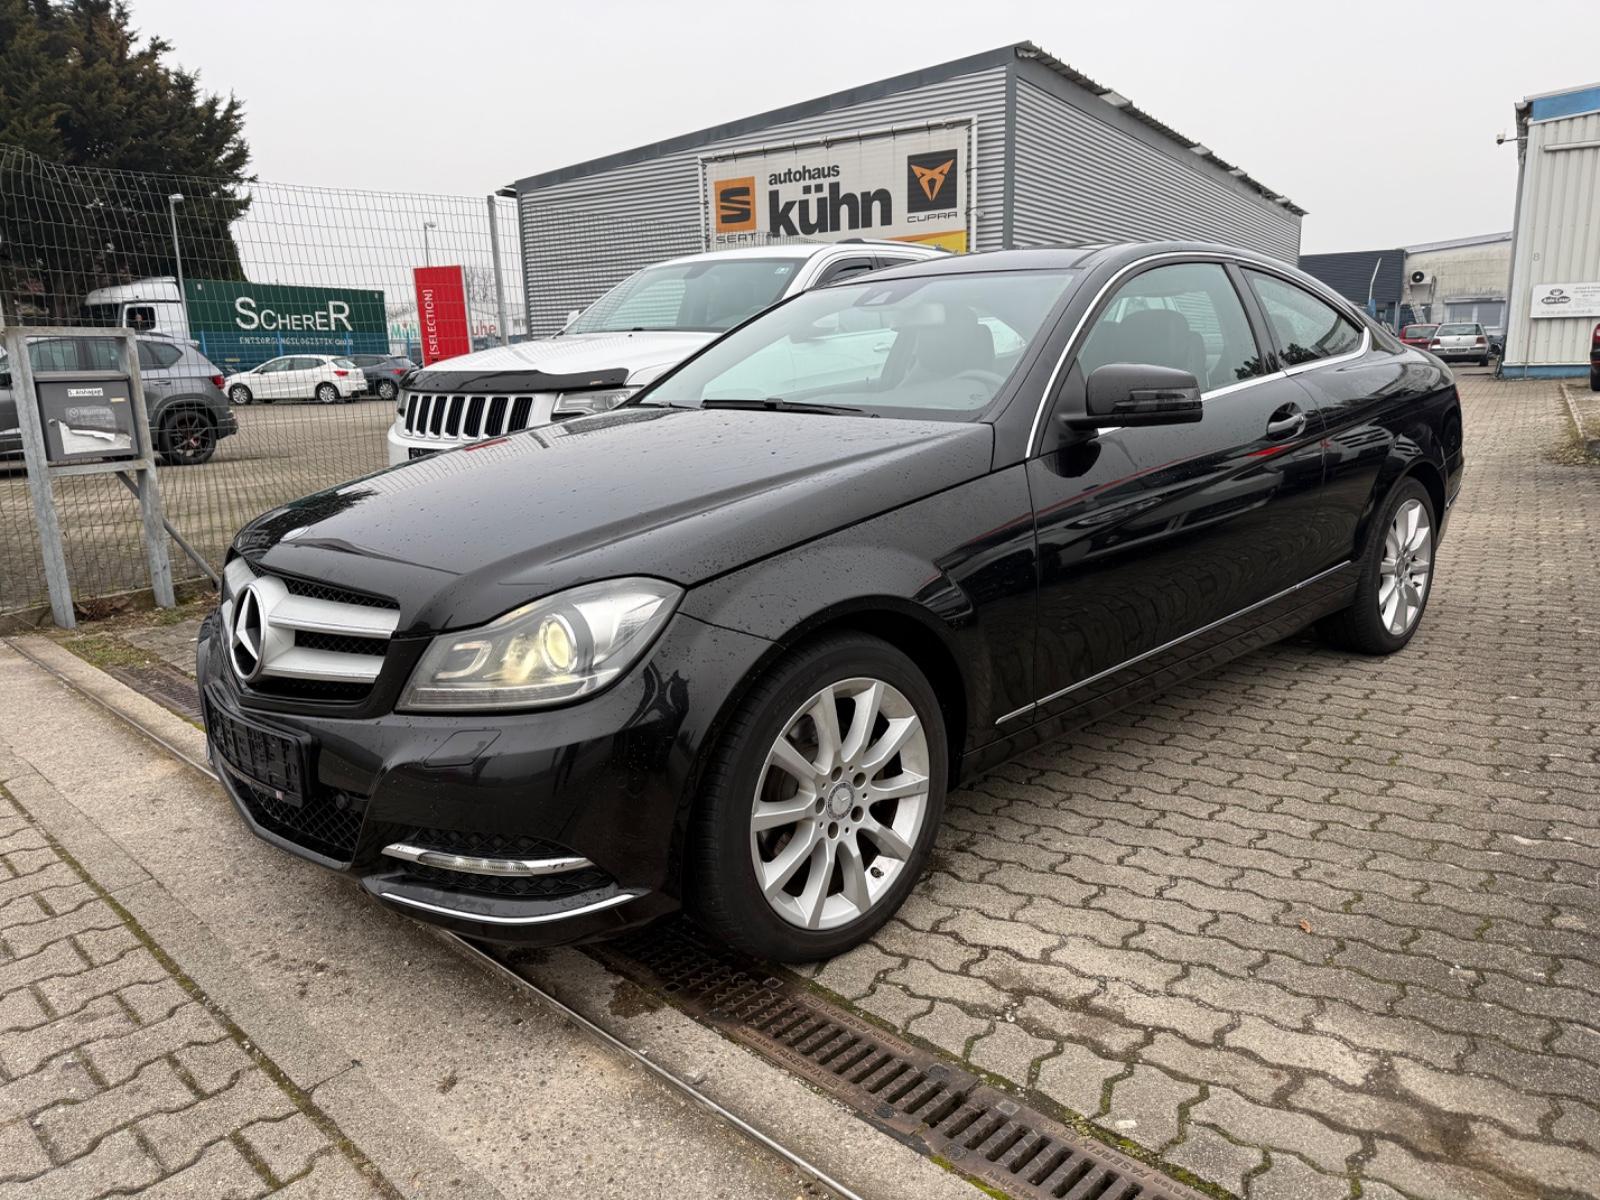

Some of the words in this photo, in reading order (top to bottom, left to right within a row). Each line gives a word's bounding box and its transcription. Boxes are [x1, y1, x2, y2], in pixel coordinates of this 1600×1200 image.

[768, 164, 840, 186] autohaus
[768, 181, 893, 238] kühn
[906, 211, 958, 223] CUPRA
[716, 232, 756, 243] SEAT
[423, 289, 440, 355] [SELECTION]
[239, 336, 333, 345] ENTSORGUNGSLOGISTIK
[1080, 1140, 1153, 1179] FASERFIX
